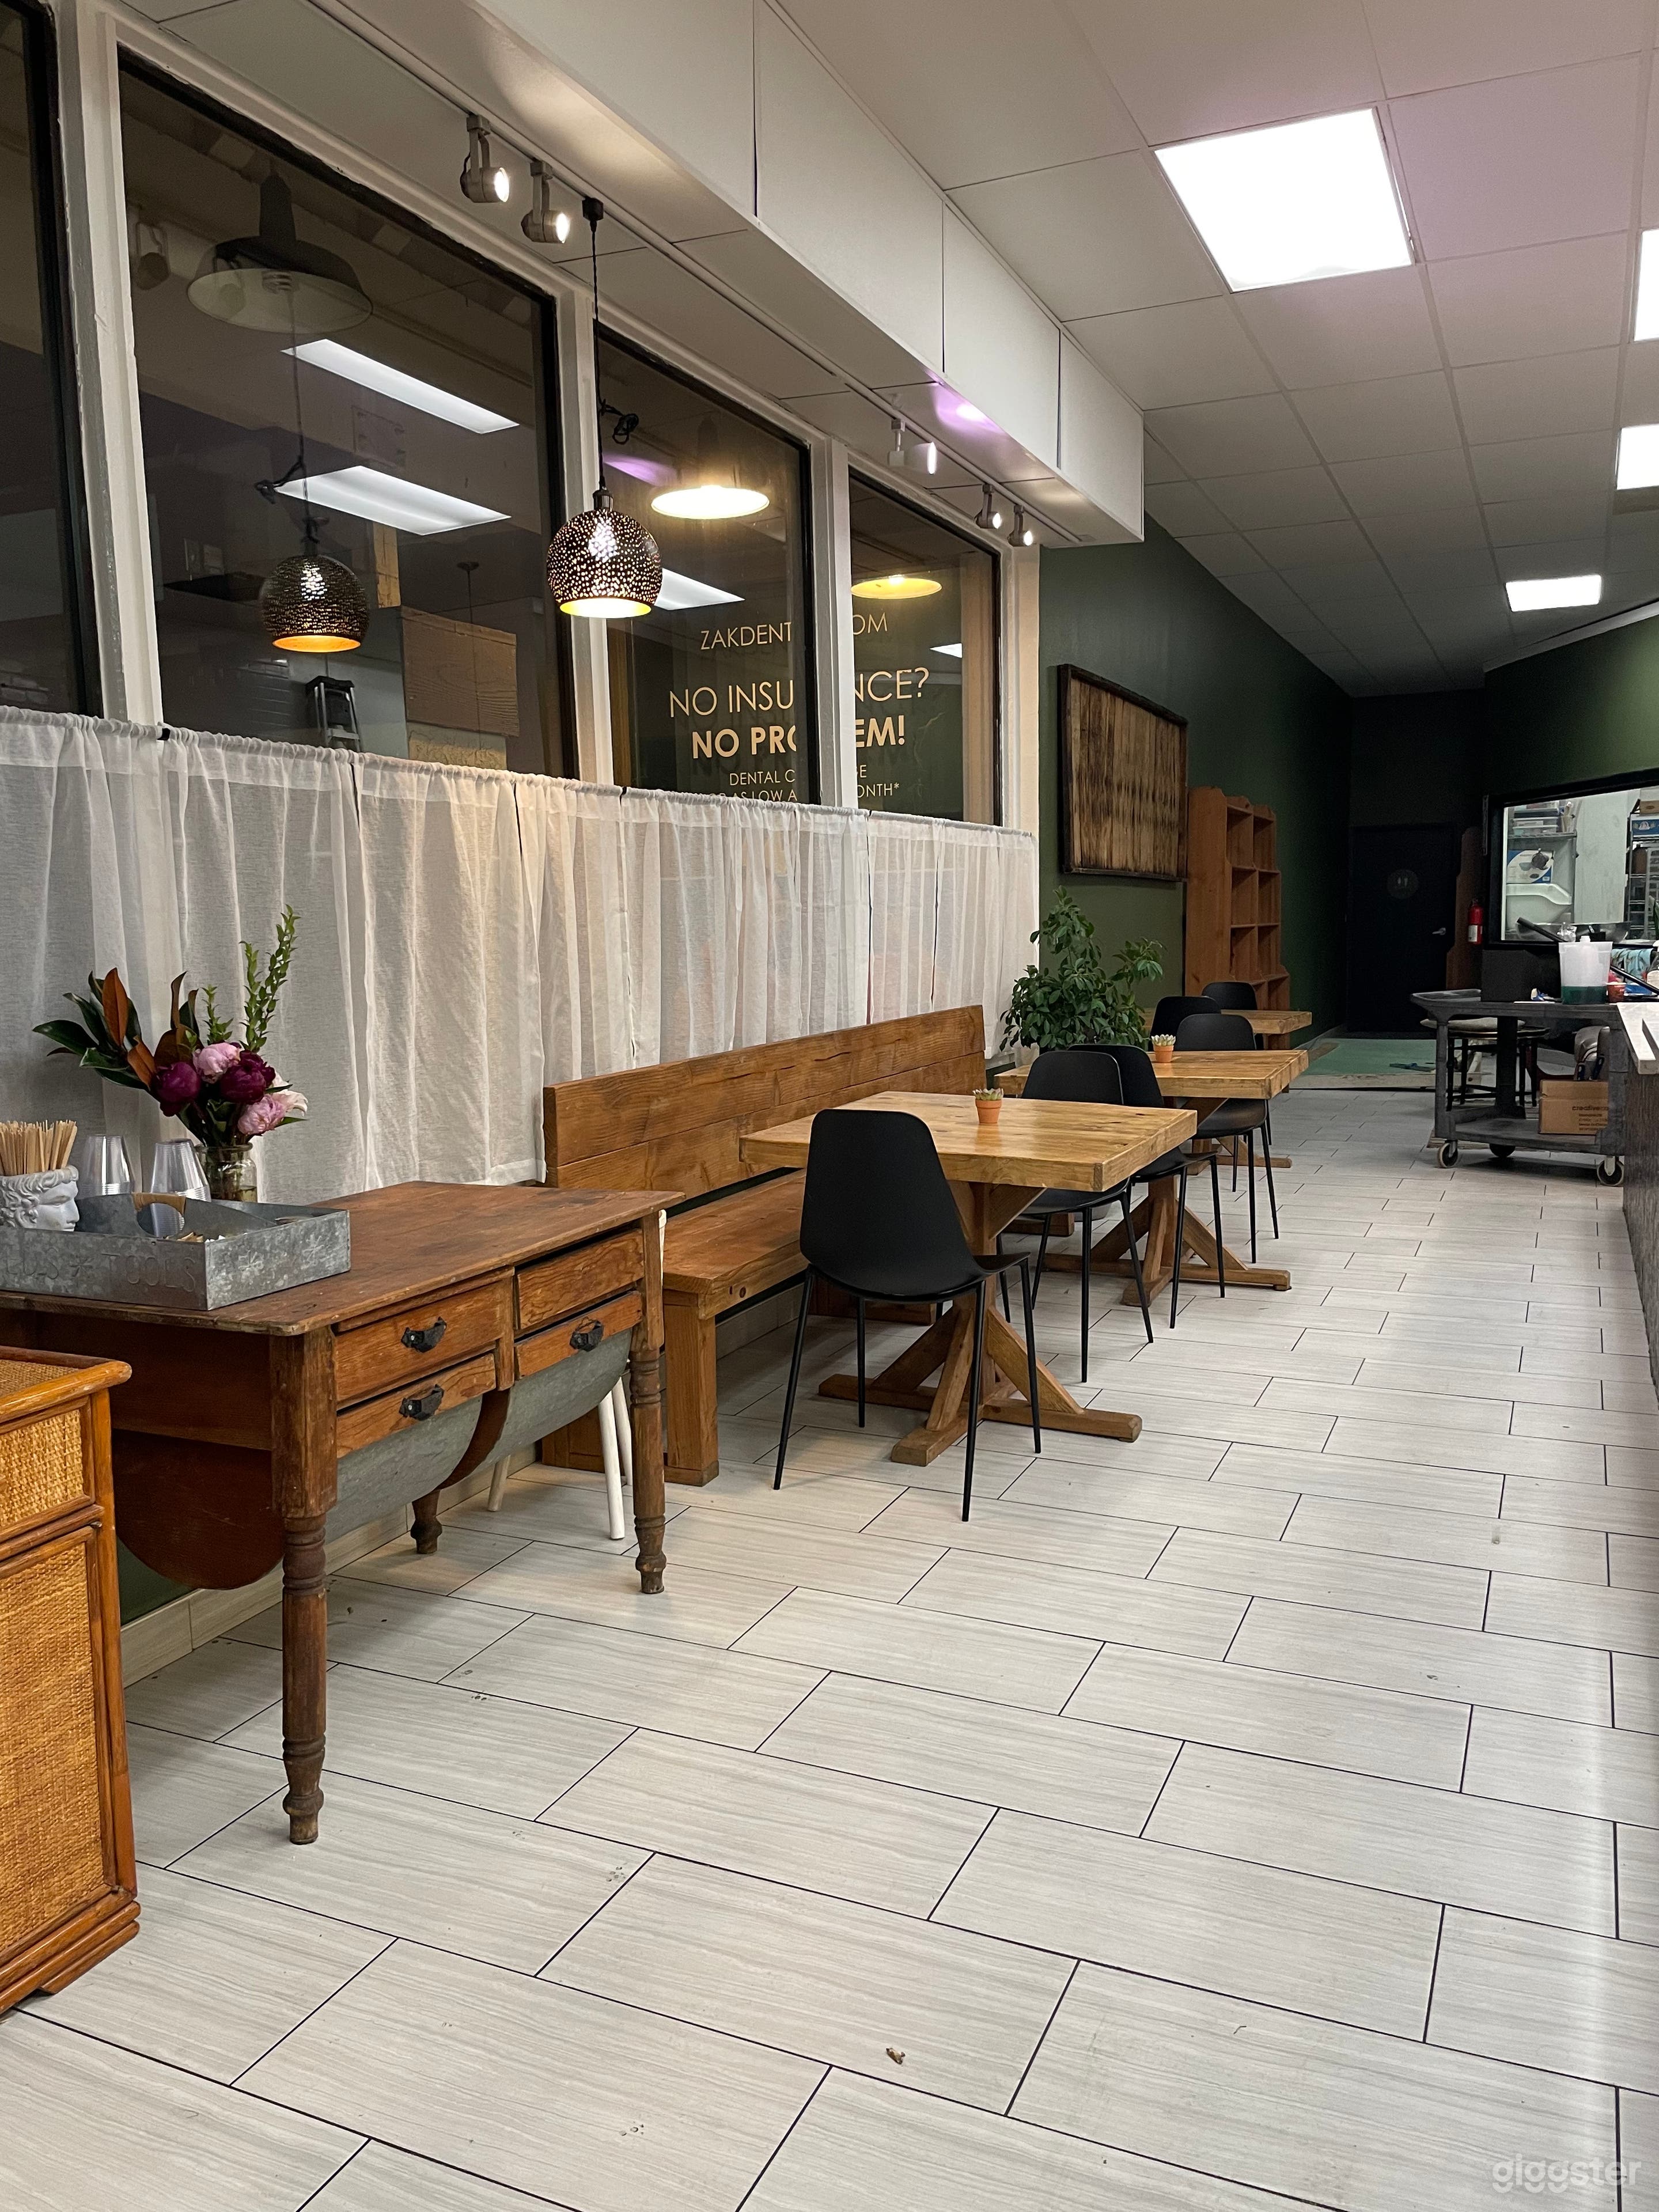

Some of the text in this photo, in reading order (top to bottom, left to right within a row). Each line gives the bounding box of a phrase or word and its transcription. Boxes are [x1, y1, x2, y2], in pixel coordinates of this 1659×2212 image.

[670, 688, 717, 718] NO
[692, 729, 740, 759] NO
[729, 770, 781, 786] DENTAL
[101, 1252, 196, 1292] TOOLS
